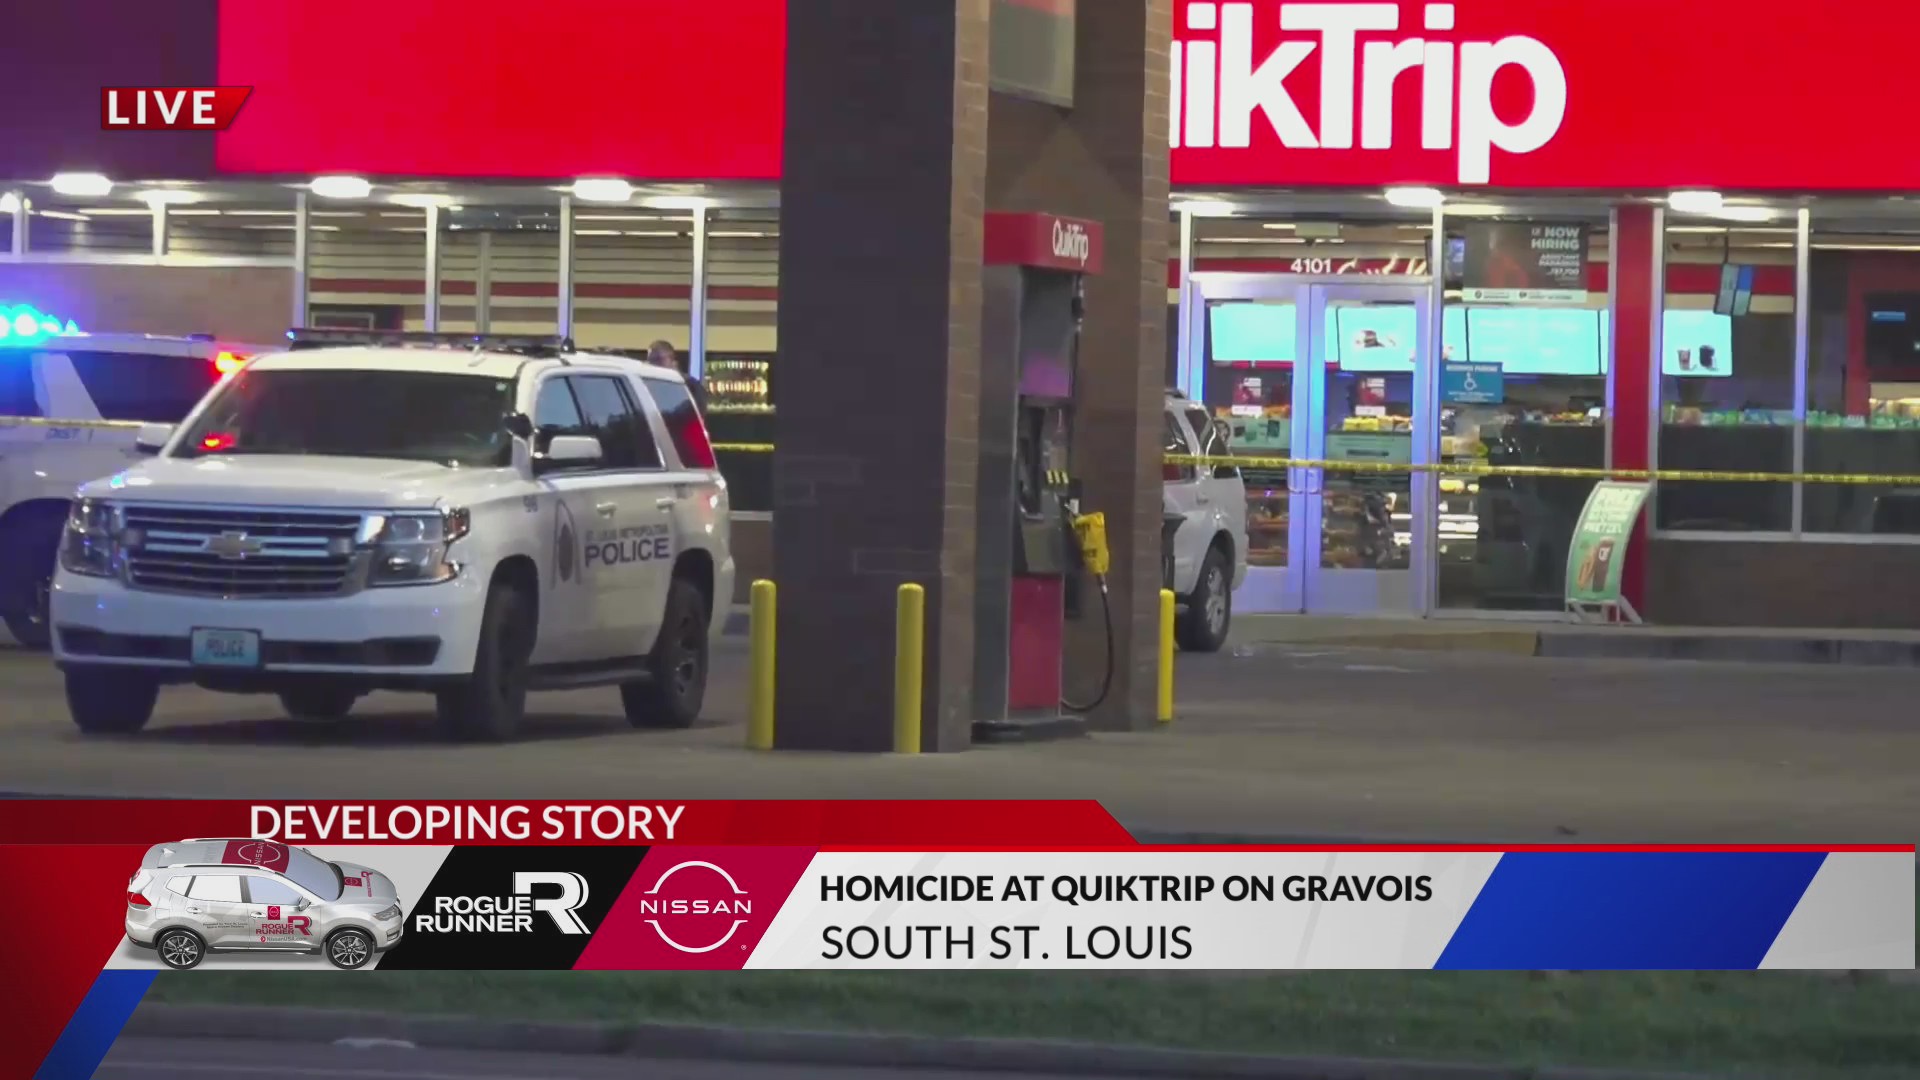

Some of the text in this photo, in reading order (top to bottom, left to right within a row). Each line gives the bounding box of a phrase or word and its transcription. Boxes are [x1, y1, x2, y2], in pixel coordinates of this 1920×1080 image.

[1545, 226, 1580, 238] NOW
[1052, 218, 1089, 267] QuikTrip
[1531, 238, 1580, 250] HIRING
[1290, 257, 1332, 274] 4101
[584, 537, 670, 568] POLICE
